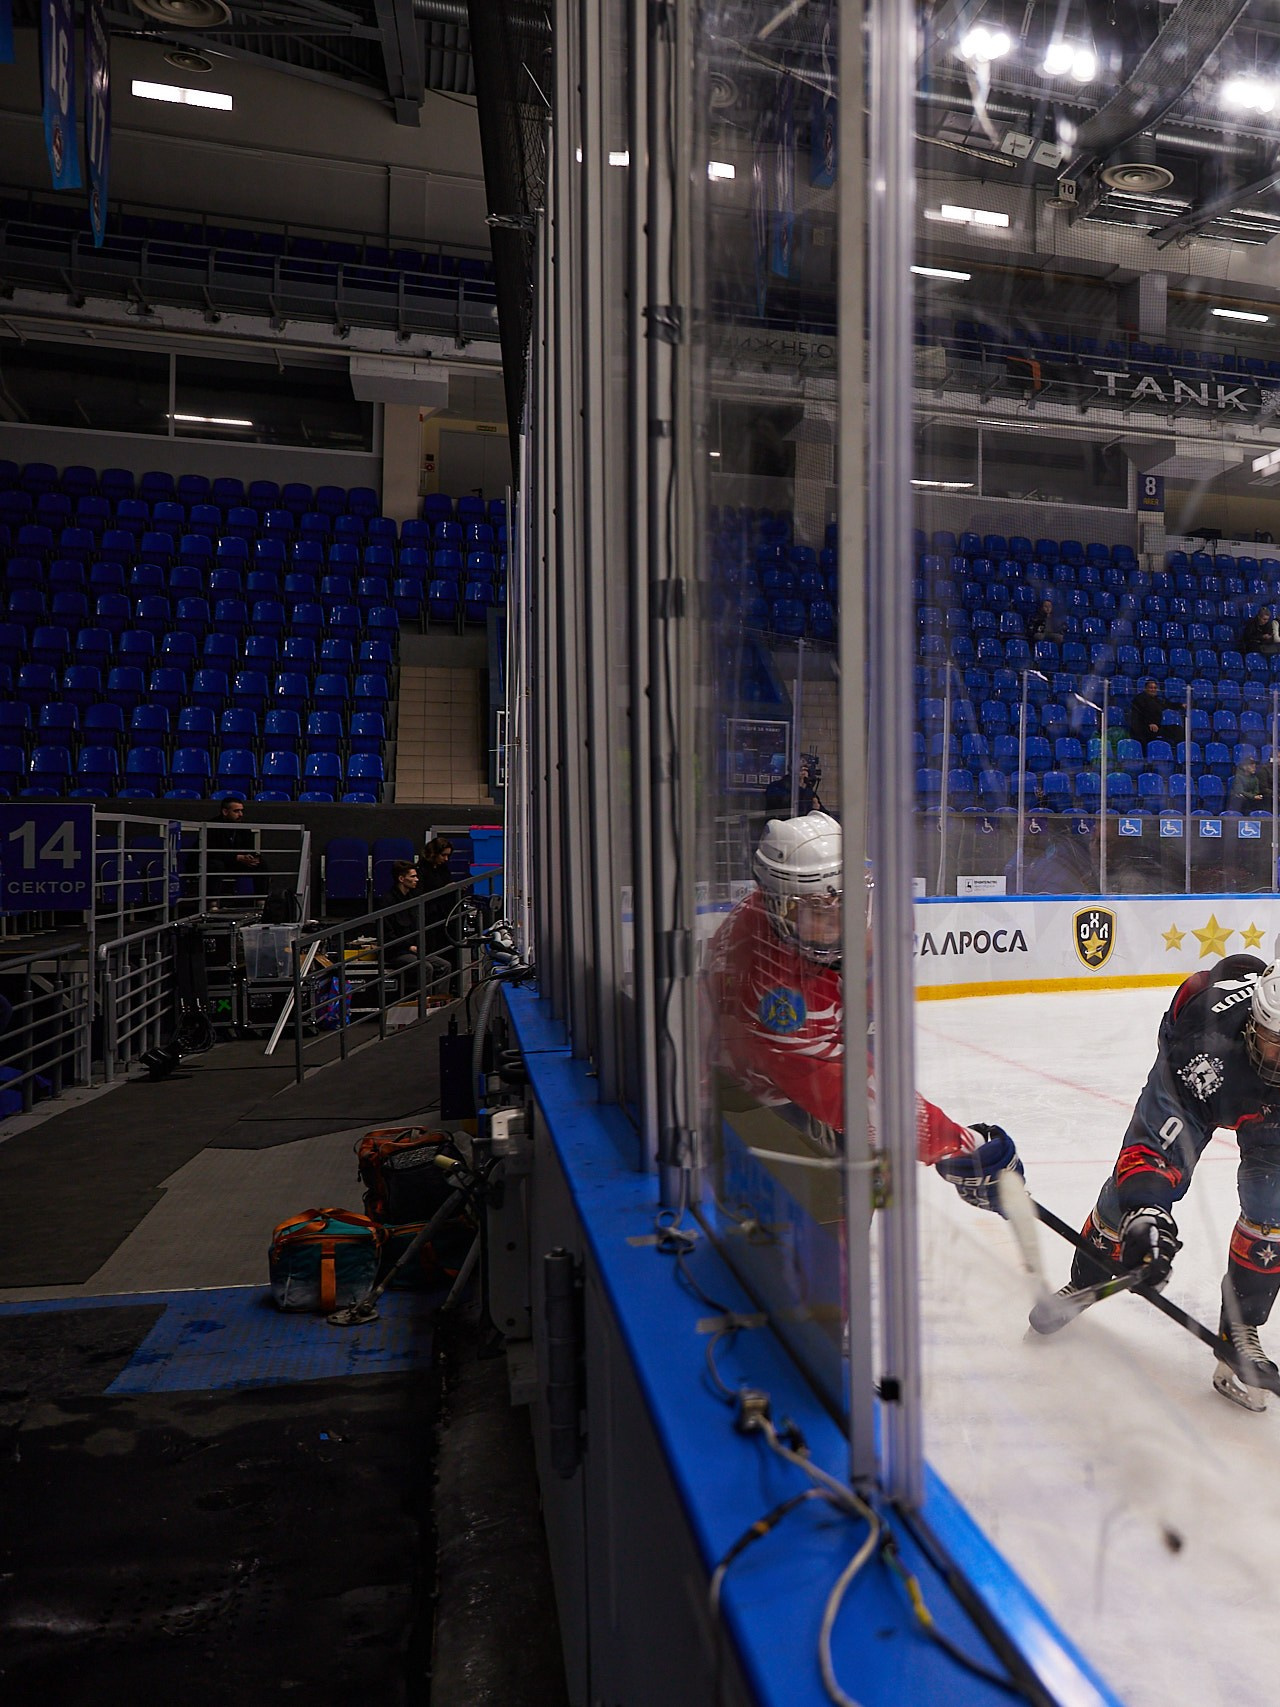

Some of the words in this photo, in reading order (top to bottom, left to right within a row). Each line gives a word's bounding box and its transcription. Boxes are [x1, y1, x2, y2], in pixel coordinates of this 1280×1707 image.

[1061, 184, 1074, 194] 10
[1093, 369, 1248, 412] TANK
[1144, 476, 1157, 497] 8
[9, 820, 82, 869] 14
[7, 881, 86, 894] СЕКТОР
[920, 929, 1028, 956] АЛРОСА
